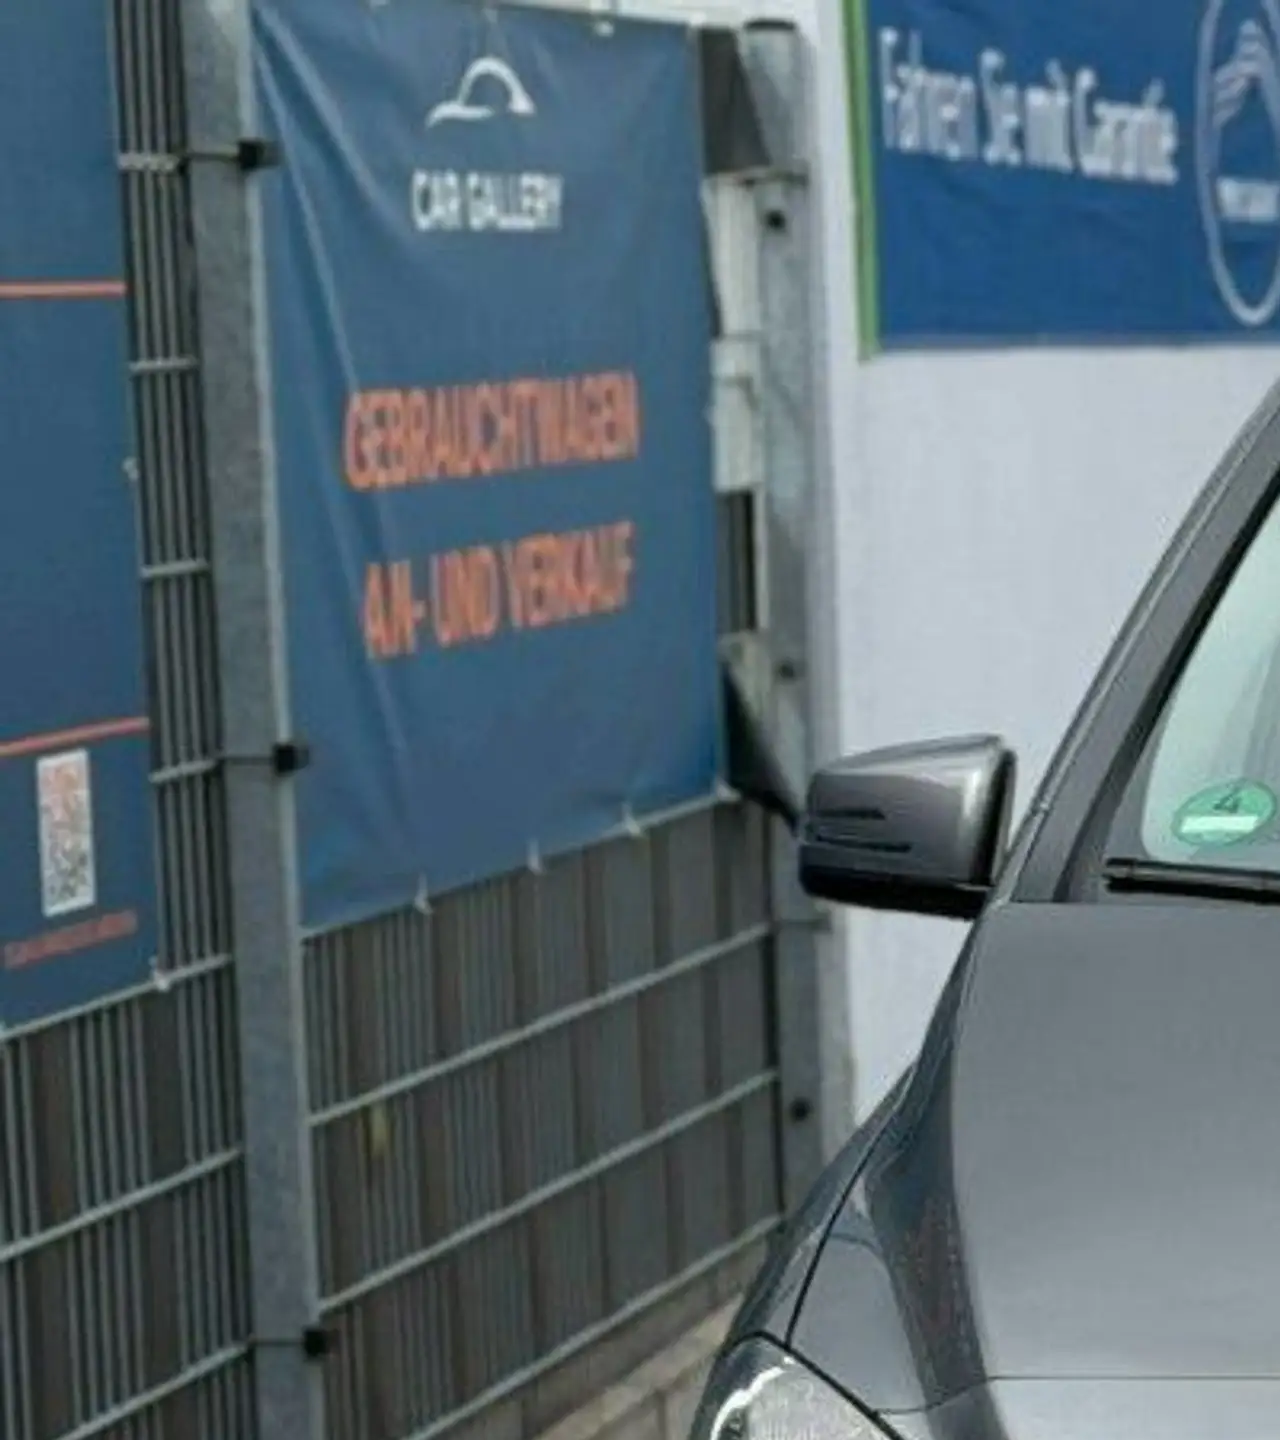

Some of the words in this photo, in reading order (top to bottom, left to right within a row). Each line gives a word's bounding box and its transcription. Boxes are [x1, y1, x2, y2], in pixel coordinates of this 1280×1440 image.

[880, 26, 977, 160] Fahren
[980, 48, 1021, 166] Sie
[1024, 60, 1072, 173] mit
[1074, 66, 1178, 186] Garantie
[411, 169, 462, 232] CAR
[466, 171, 562, 232] GALLERY
[343, 371, 639, 492] GEBRAUCHTWAGEN
[429, 545, 499, 648] UND
[502, 521, 633, 632] VERKAUF
